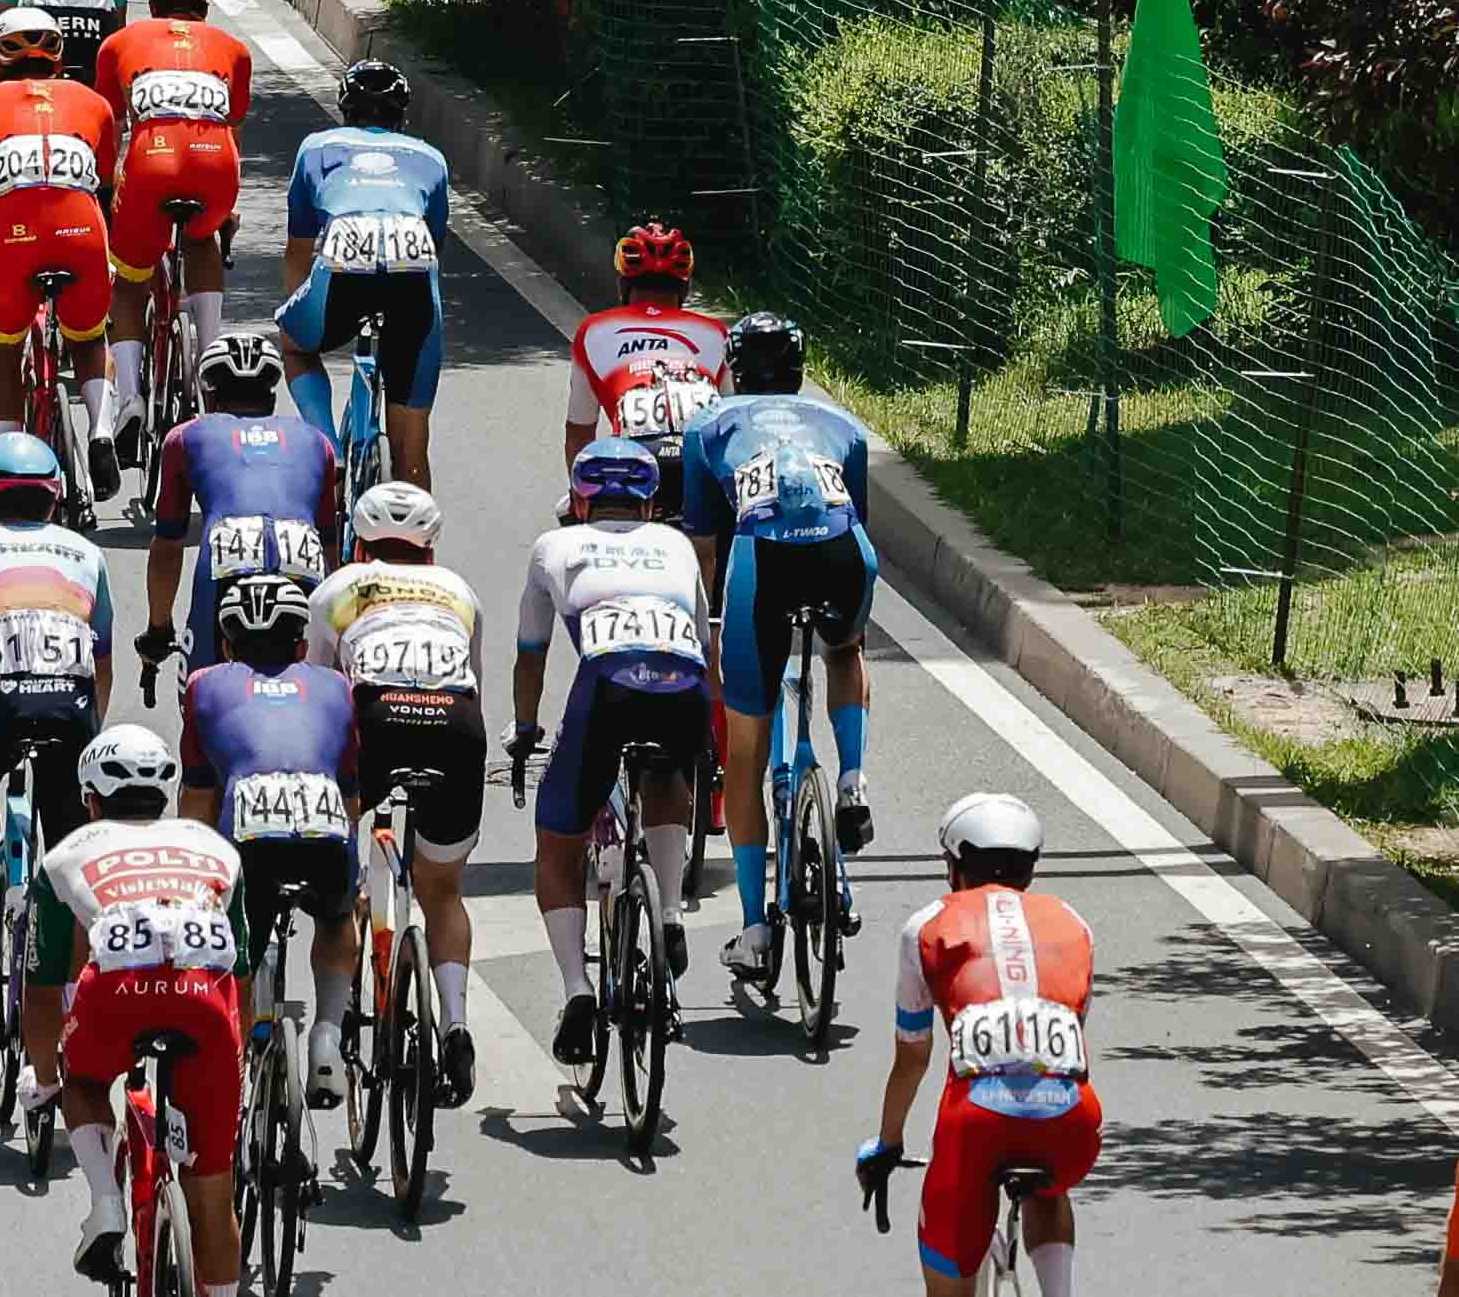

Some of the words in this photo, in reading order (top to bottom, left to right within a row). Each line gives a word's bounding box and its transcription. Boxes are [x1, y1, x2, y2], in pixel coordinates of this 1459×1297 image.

[388, 230, 432, 258] 184
[618, 338, 669, 357] ANTA
[658, 444, 680, 456] ANTA
[588, 614, 641, 644] 174
[649, 612, 697, 643] 174
[43, 634, 84, 661] 51
[20, 682, 76, 693] HEART
[381, 694, 454, 704] HUANSHENG
[390, 706, 446, 715] VONDA
[296, 784, 347, 827] 144
[96, 849, 222, 871] POLTI
[107, 920, 151, 951] 85
[184, 921, 227, 950] 85
[995, 895, 1028, 982] LI-NING
[116, 981, 208, 994] AURUM
[960, 1015, 1013, 1055] 161
[1031, 1015, 1080, 1057] 161
[171, 1121, 185, 1150] 85
